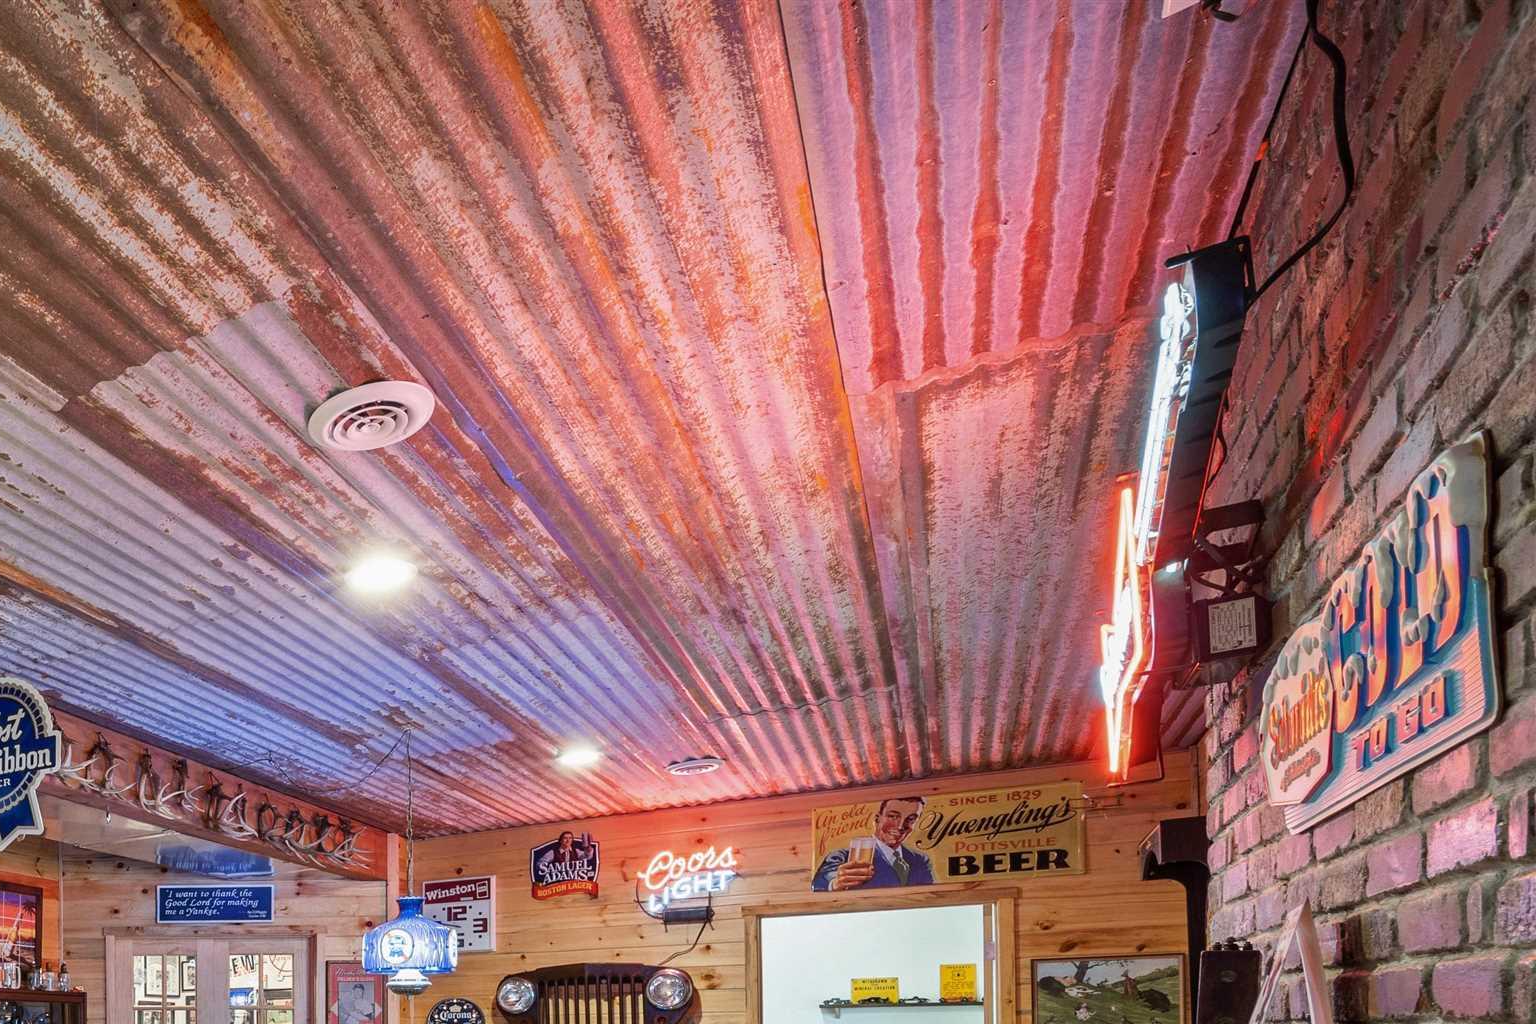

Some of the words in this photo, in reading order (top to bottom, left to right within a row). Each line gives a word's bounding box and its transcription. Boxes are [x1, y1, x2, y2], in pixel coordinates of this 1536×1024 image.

[1332, 484, 1464, 734] COLD
[1352, 717, 1389, 772] TO
[1398, 674, 1446, 739] GO
[949, 795, 997, 807] SINCE
[1006, 790, 1041, 801] 1829
[815, 810, 839, 829] An
[840, 804, 866, 821] old
[915, 797, 1077, 850] Yuengling's
[817, 811, 874, 856] friend
[954, 836, 1057, 854] POTTSVILLE
[539, 858, 593, 875] SAMUEL
[636, 845, 737, 890] Coors
[948, 850, 1071, 877] BEER
[543, 869, 588, 886] ADAMS
[175, 890, 198, 898] want
[211, 889, 239, 899] thank
[239, 888, 253, 897] the
[425, 883, 476, 900] Winston
[537, 884, 567, 897] BOSTON
[568, 881, 593, 890] LAGER
[648, 870, 737, 911] LIGHT
[164, 899, 187, 908] Good
[189, 898, 210, 907] Lord
[211, 898, 225, 908] for
[227, 897, 259, 908] making
[447, 905, 468, 922] 12
[473, 917, 489, 933] 3
[440, 1010, 472, 1021] Corona
